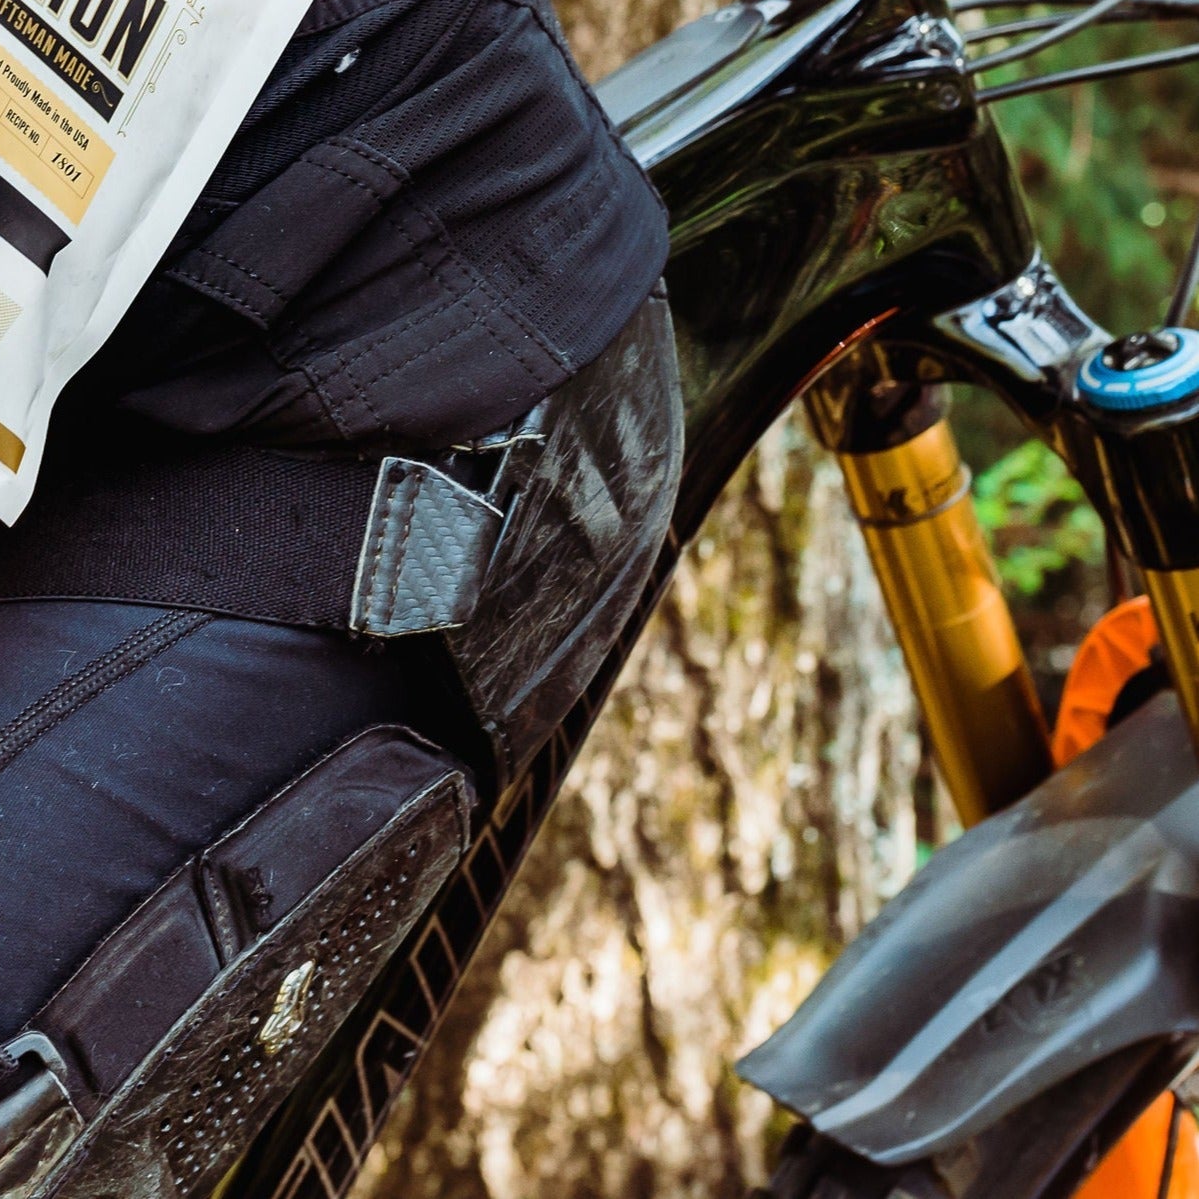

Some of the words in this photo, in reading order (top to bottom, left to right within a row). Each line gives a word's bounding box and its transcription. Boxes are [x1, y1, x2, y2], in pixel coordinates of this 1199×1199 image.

[53, 45, 94, 91] MADE
[2, 65, 32, 97] Proudly
[30, 90, 52, 115] Made
[51, 109, 60, 124] in
[60, 117, 73, 135] the
[72, 129, 89, 151] USA
[5, 108, 30, 135] RECIPE
[28, 129, 40, 146] NO.
[51, 152, 82, 183] 1801
